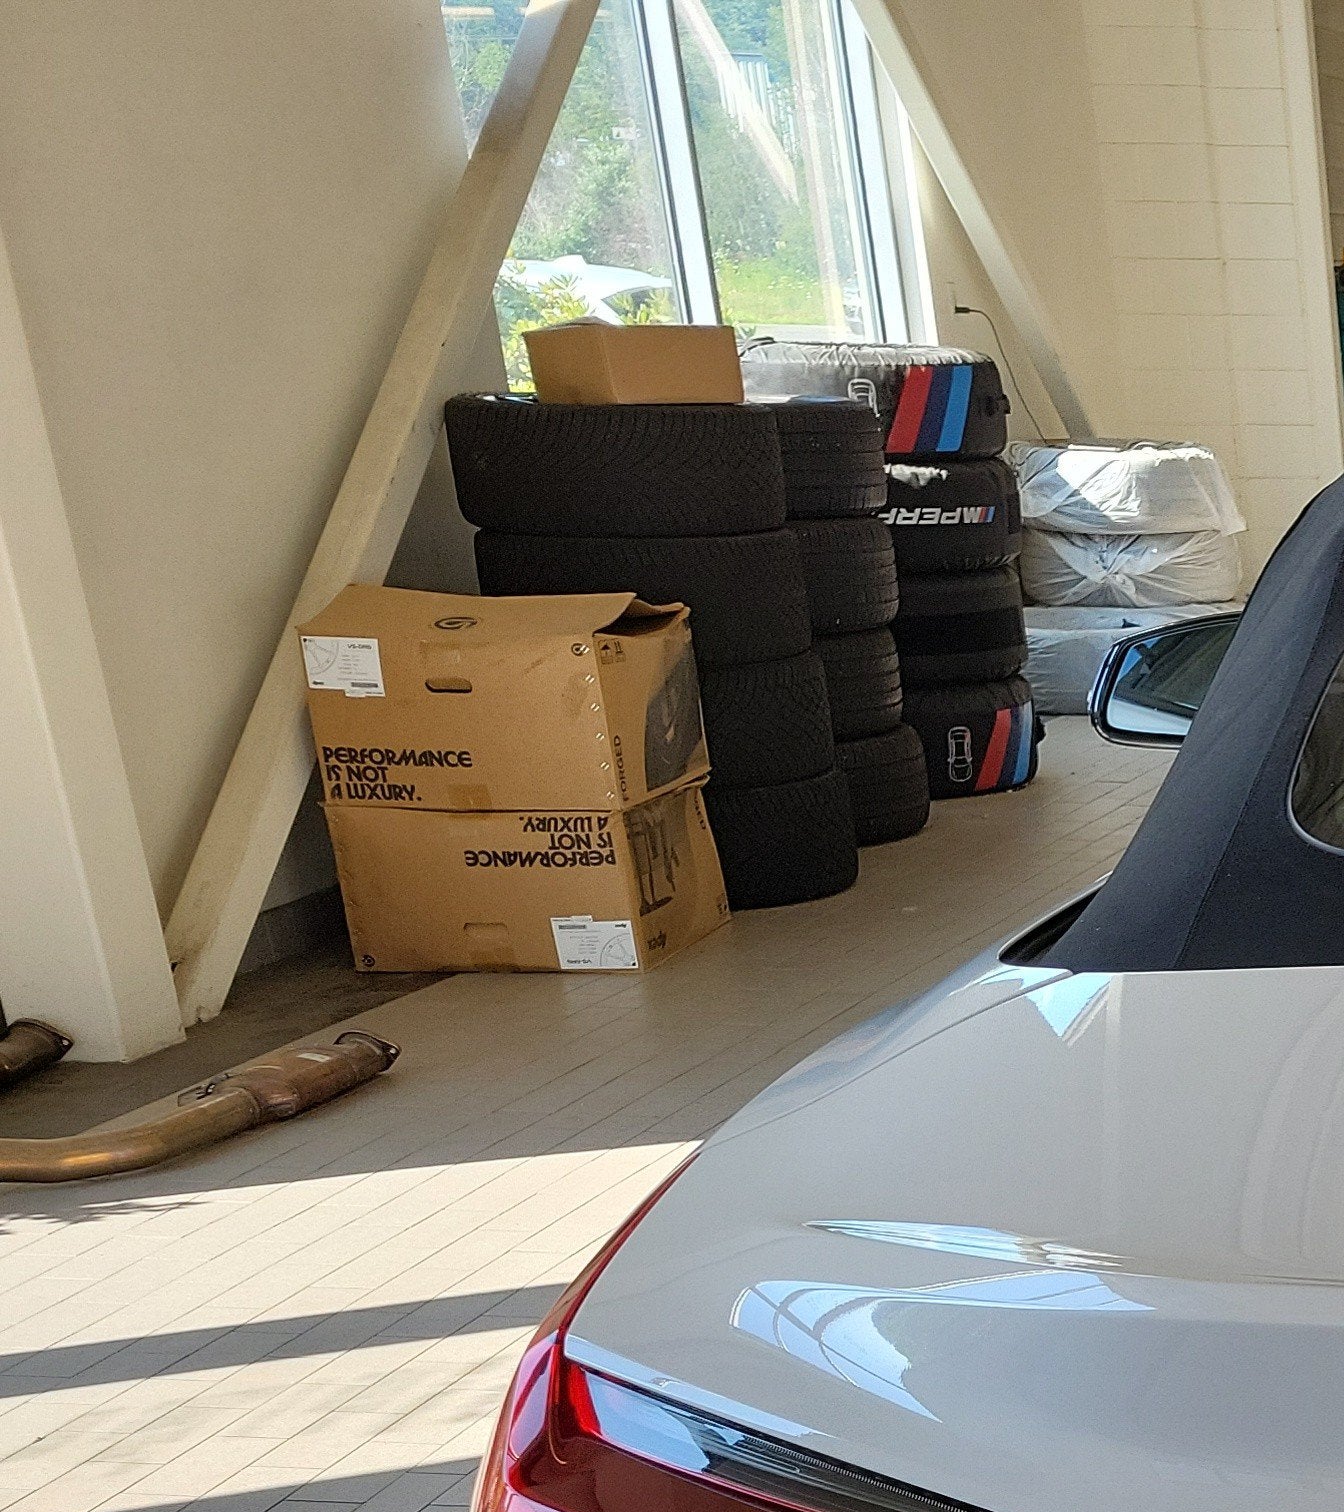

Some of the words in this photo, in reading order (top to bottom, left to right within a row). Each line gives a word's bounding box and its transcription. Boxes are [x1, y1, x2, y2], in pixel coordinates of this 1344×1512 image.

[877, 506, 981, 525] MPERF
[322, 746, 473, 768] PERFORMANCE
[326, 765, 342, 782] IS
[349, 765, 389, 783] NOT
[613, 735, 630, 801] FORGED
[330, 783, 343, 800] A
[346, 783, 422, 802] LUXURY.
[518, 816, 593, 833] LUXURY.
[597, 816, 609, 831] A
[548, 833, 592, 851] NOT
[597, 832, 613, 849] IS
[464, 850, 616, 868] PERFORMANCE
